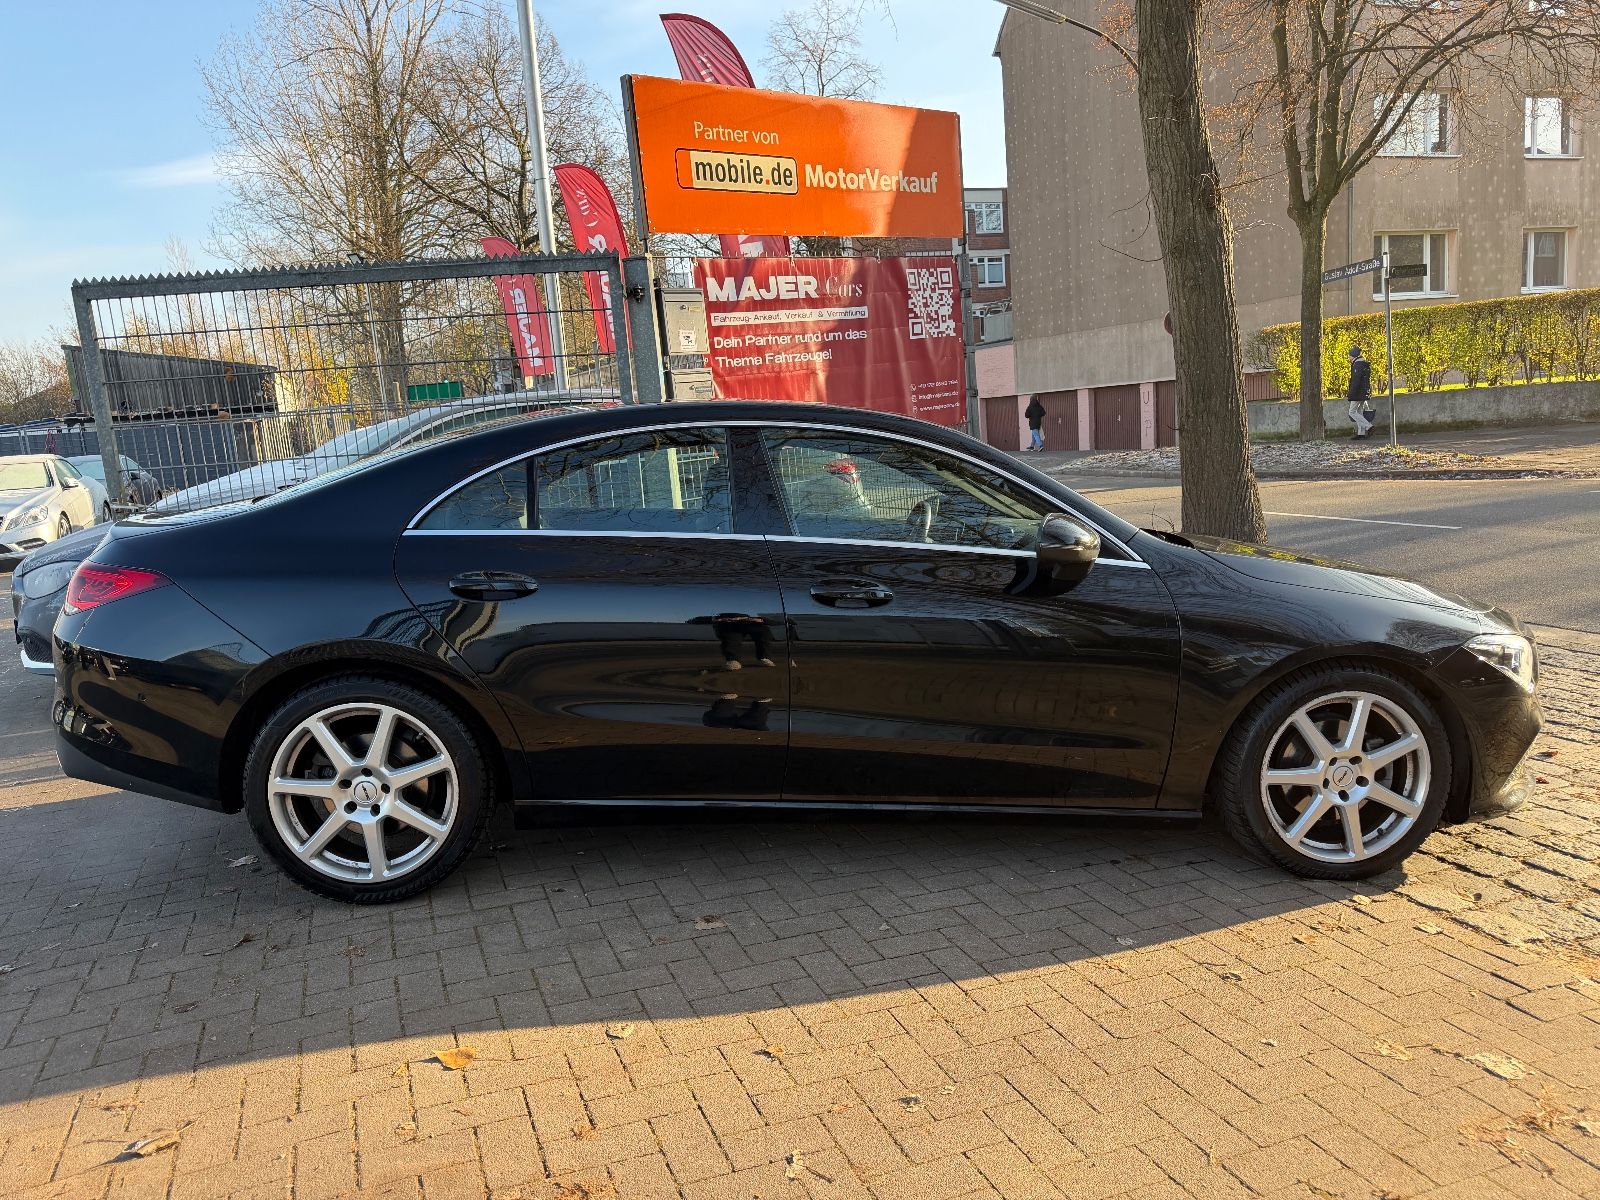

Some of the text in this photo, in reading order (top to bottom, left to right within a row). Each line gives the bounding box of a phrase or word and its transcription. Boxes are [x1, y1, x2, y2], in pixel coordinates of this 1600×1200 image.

[693, 121, 779, 145] Partner von
[694, 158, 938, 194] mobile.de MotorVerkauf
[705, 275, 863, 302] MAJER Cars
[713, 314, 752, 324] Fahrzeug-
[784, 311, 813, 320] Verkauf
[817, 310, 824, 318] &
[713, 328, 868, 349] Dein Partner rund um das
[714, 348, 833, 368] Thema Fahrzeuge!
